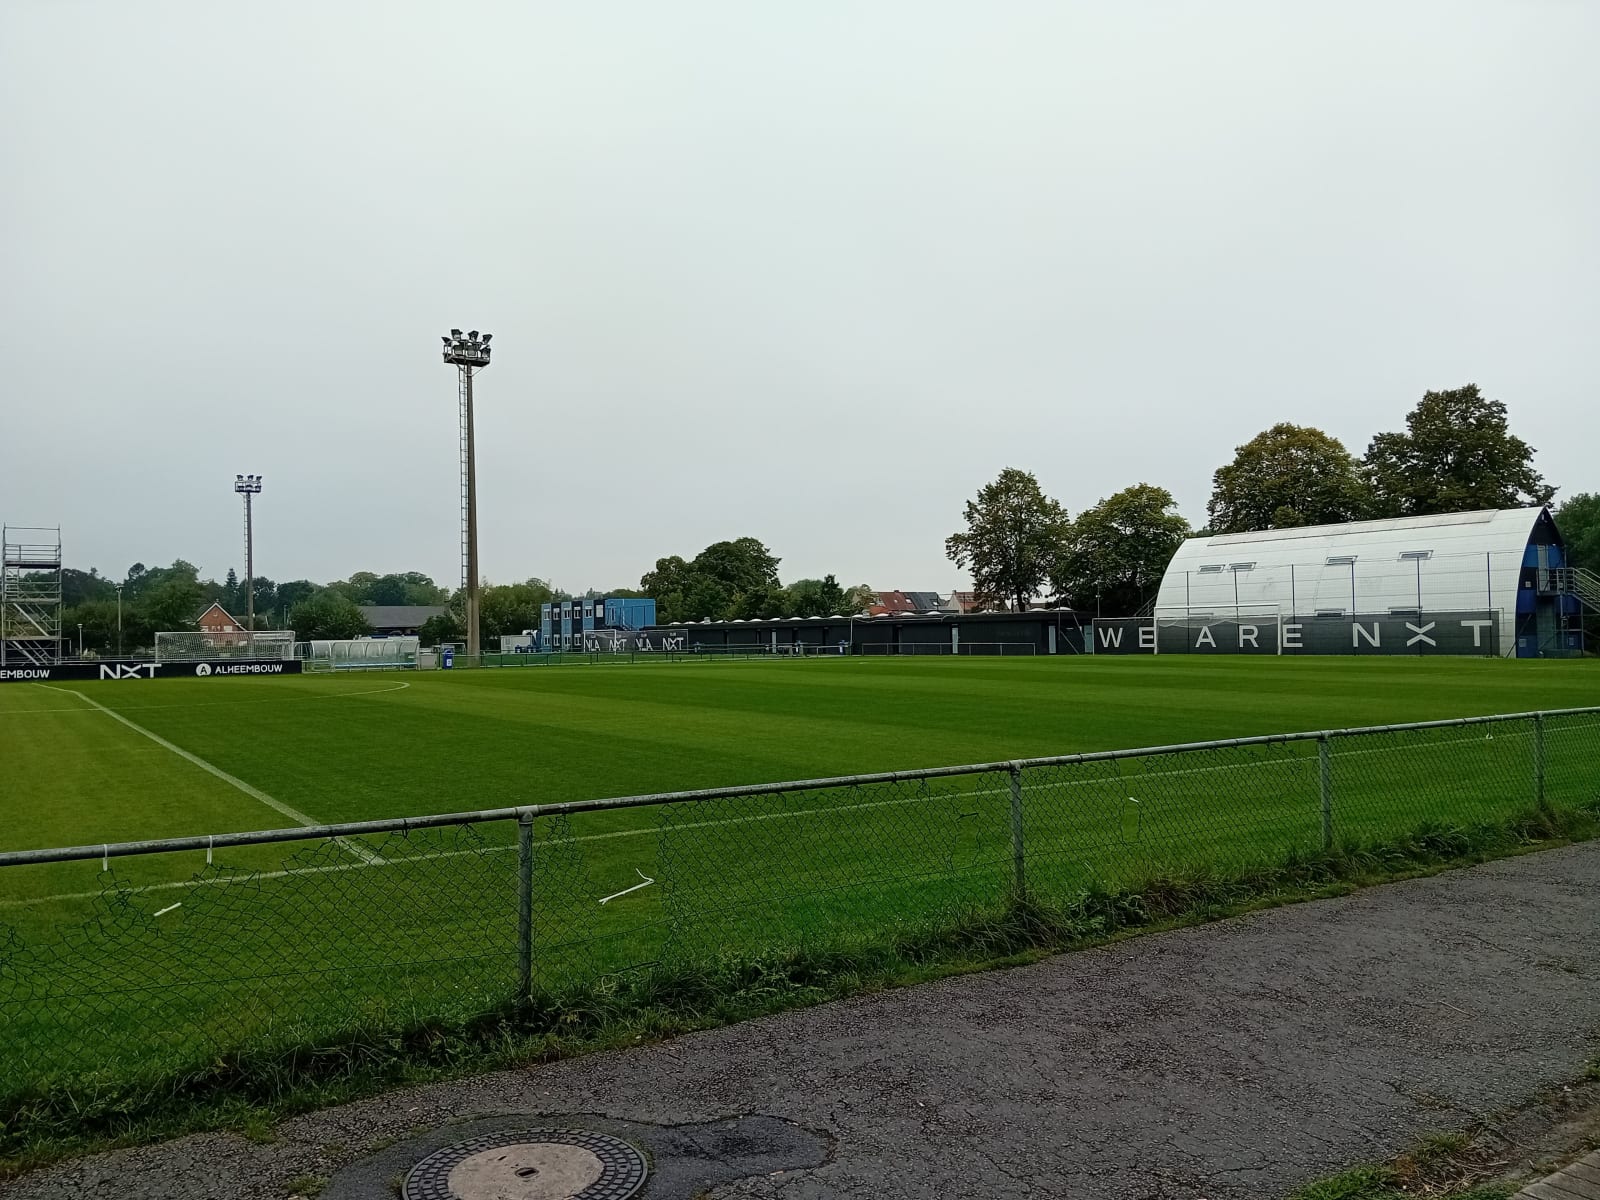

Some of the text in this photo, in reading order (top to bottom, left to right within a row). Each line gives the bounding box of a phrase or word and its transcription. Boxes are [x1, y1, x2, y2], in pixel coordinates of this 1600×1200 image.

[1098, 620, 1493, 648] WE ARE NXT
[609, 638, 627, 652] NXT
[662, 637, 684, 651] NXT
[100, 663, 162, 680] NXT
[215, 664, 283, 674] ALHEEMBOUW
